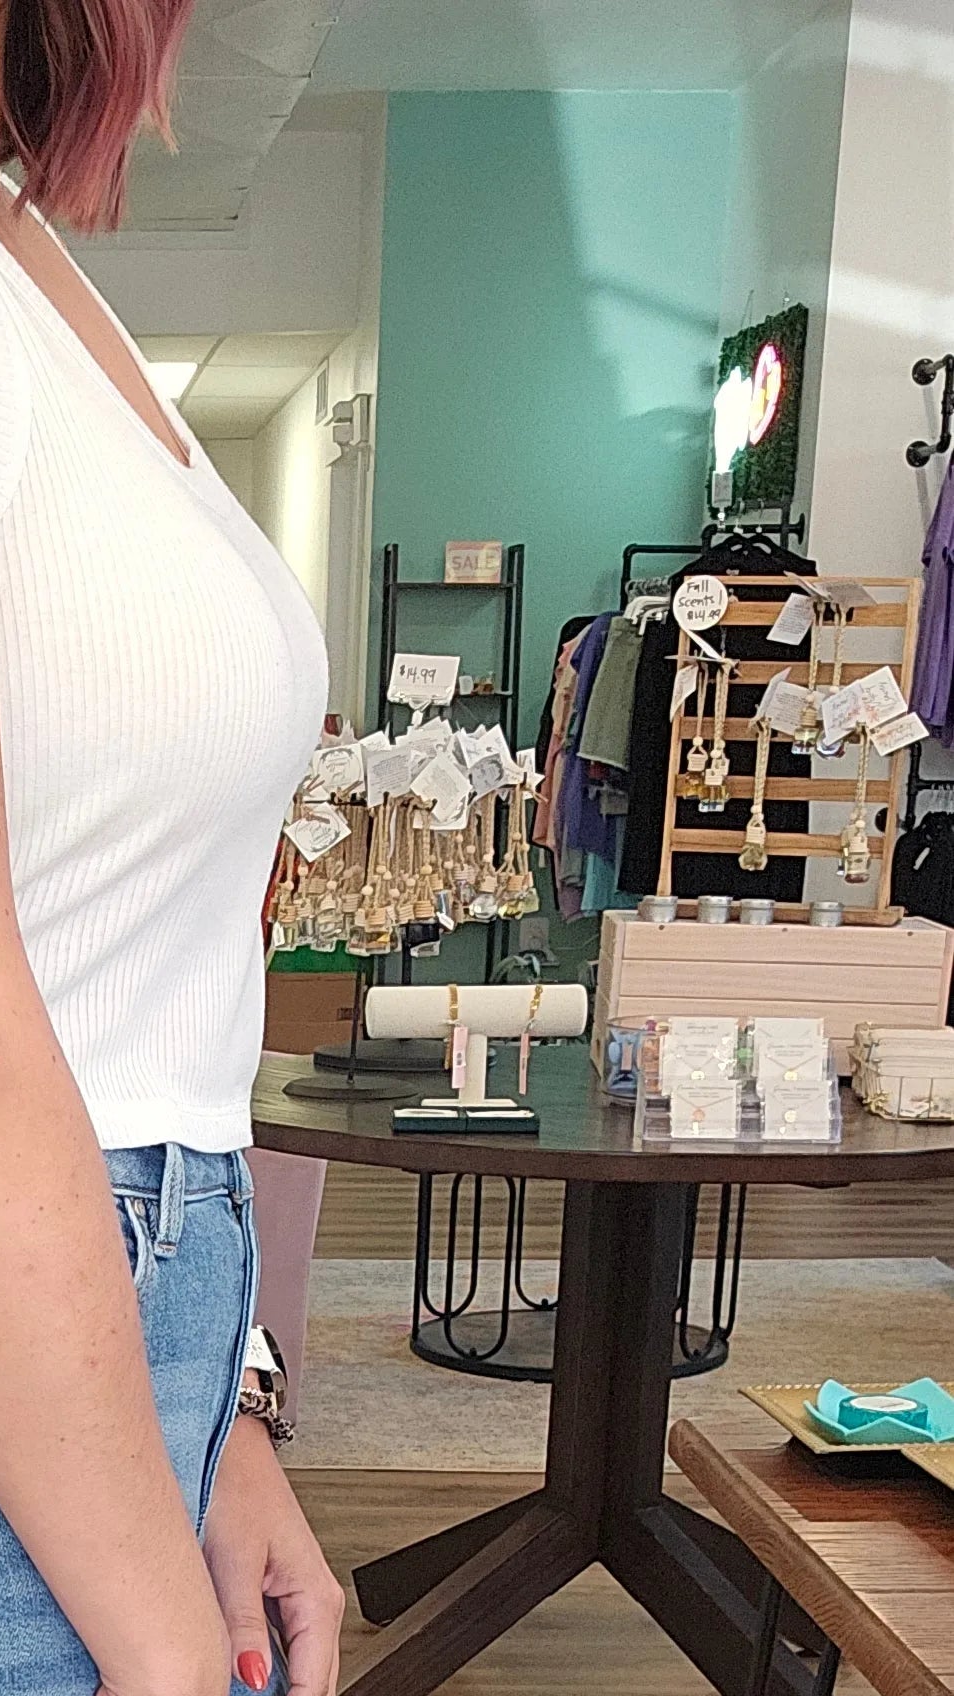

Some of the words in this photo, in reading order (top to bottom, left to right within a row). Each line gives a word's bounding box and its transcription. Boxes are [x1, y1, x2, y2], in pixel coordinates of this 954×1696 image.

[451, 555, 495, 570] SALE
[686, 579, 709, 594] Fall
[399, 664, 437, 684] $14.99
